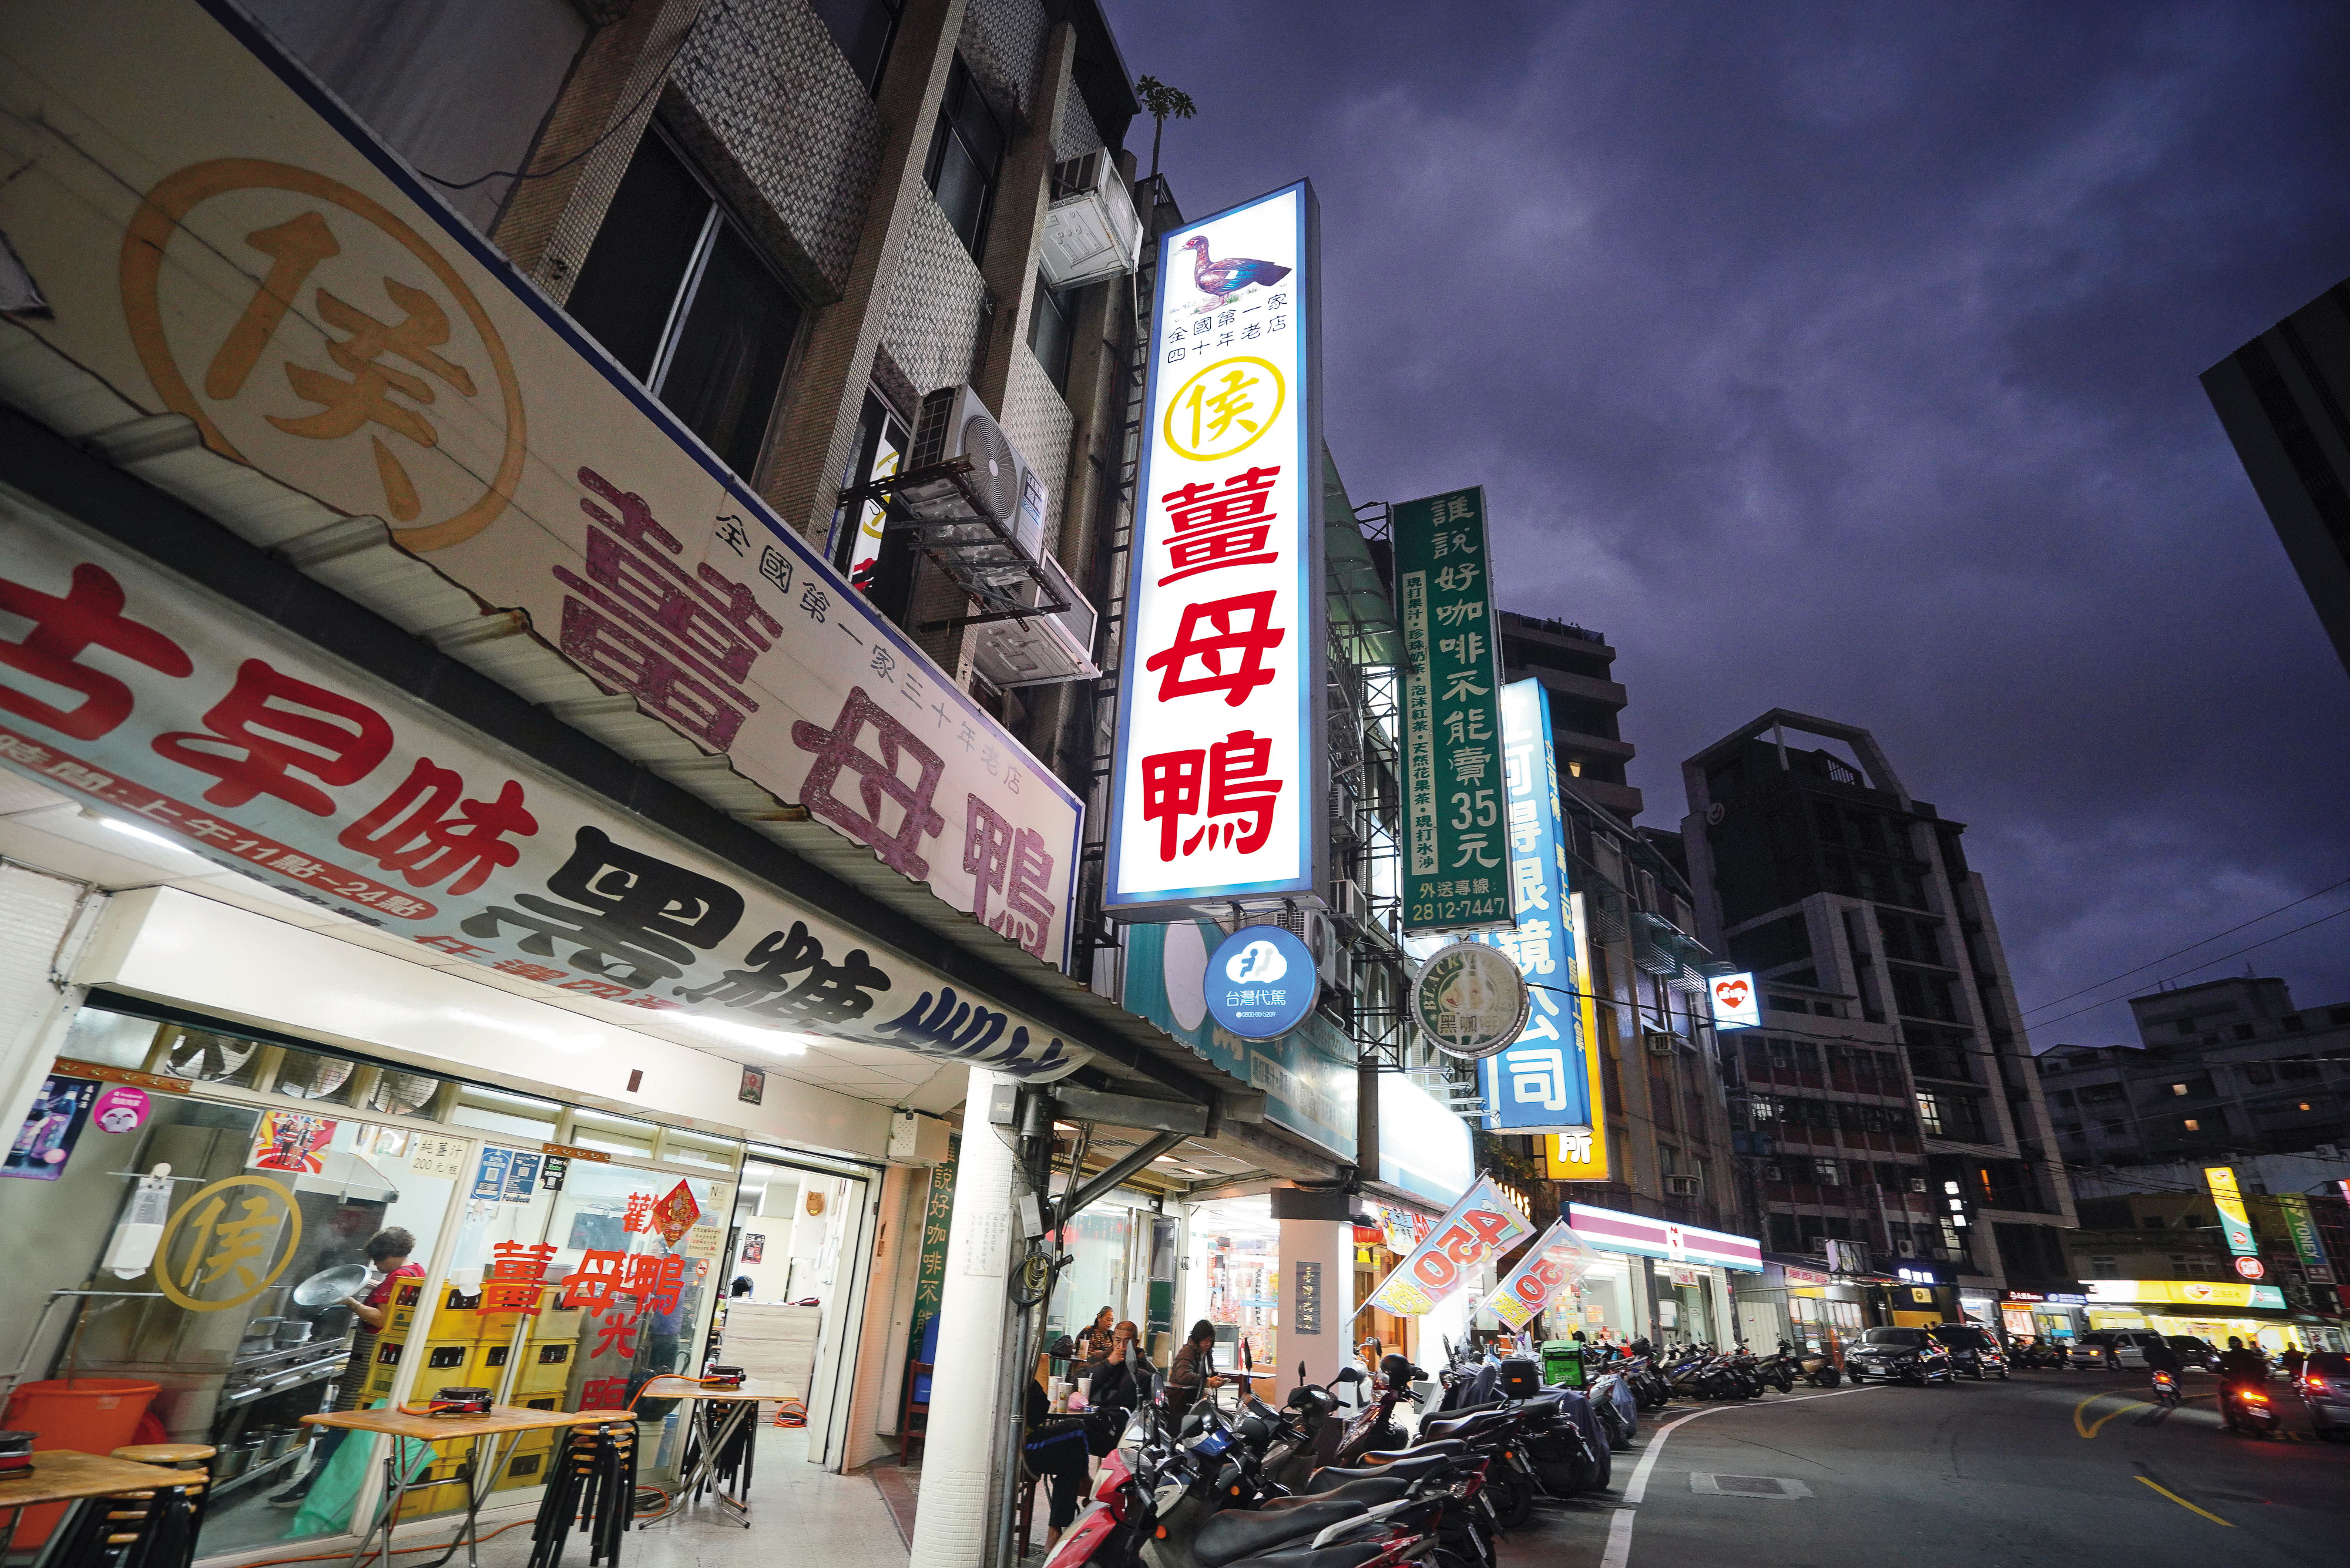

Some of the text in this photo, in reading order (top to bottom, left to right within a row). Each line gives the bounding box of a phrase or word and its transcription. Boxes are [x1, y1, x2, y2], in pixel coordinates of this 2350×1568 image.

[1168, 315, 1287, 364] 四十年老店
[1169, 294, 1287, 344] 全國第一家
[206, 211, 478, 521] 侯
[1186, 370, 1260, 449] 侯
[717, 513, 1021, 795] 全國第一家三十年老店
[1142, 465, 1285, 862] 薑母鴨
[1430, 495, 1502, 869] 誰說好咖啡不能賣35元
[552, 466, 1056, 960] 薑母鴨
[1413, 897, 1505, 921] 2812-7447
[1226, 990, 1286, 1006] 台灣代駕
[1423, 956, 1461, 1010] BLACK
[413, 1158, 432, 1170] 200
[419, 1140, 463, 1157] 純薑汁
[180, 1196, 282, 1291] 侯
[2293, 1221, 2321, 1258] YONEX
[476, 1240, 686, 1318] 薑母鴨
